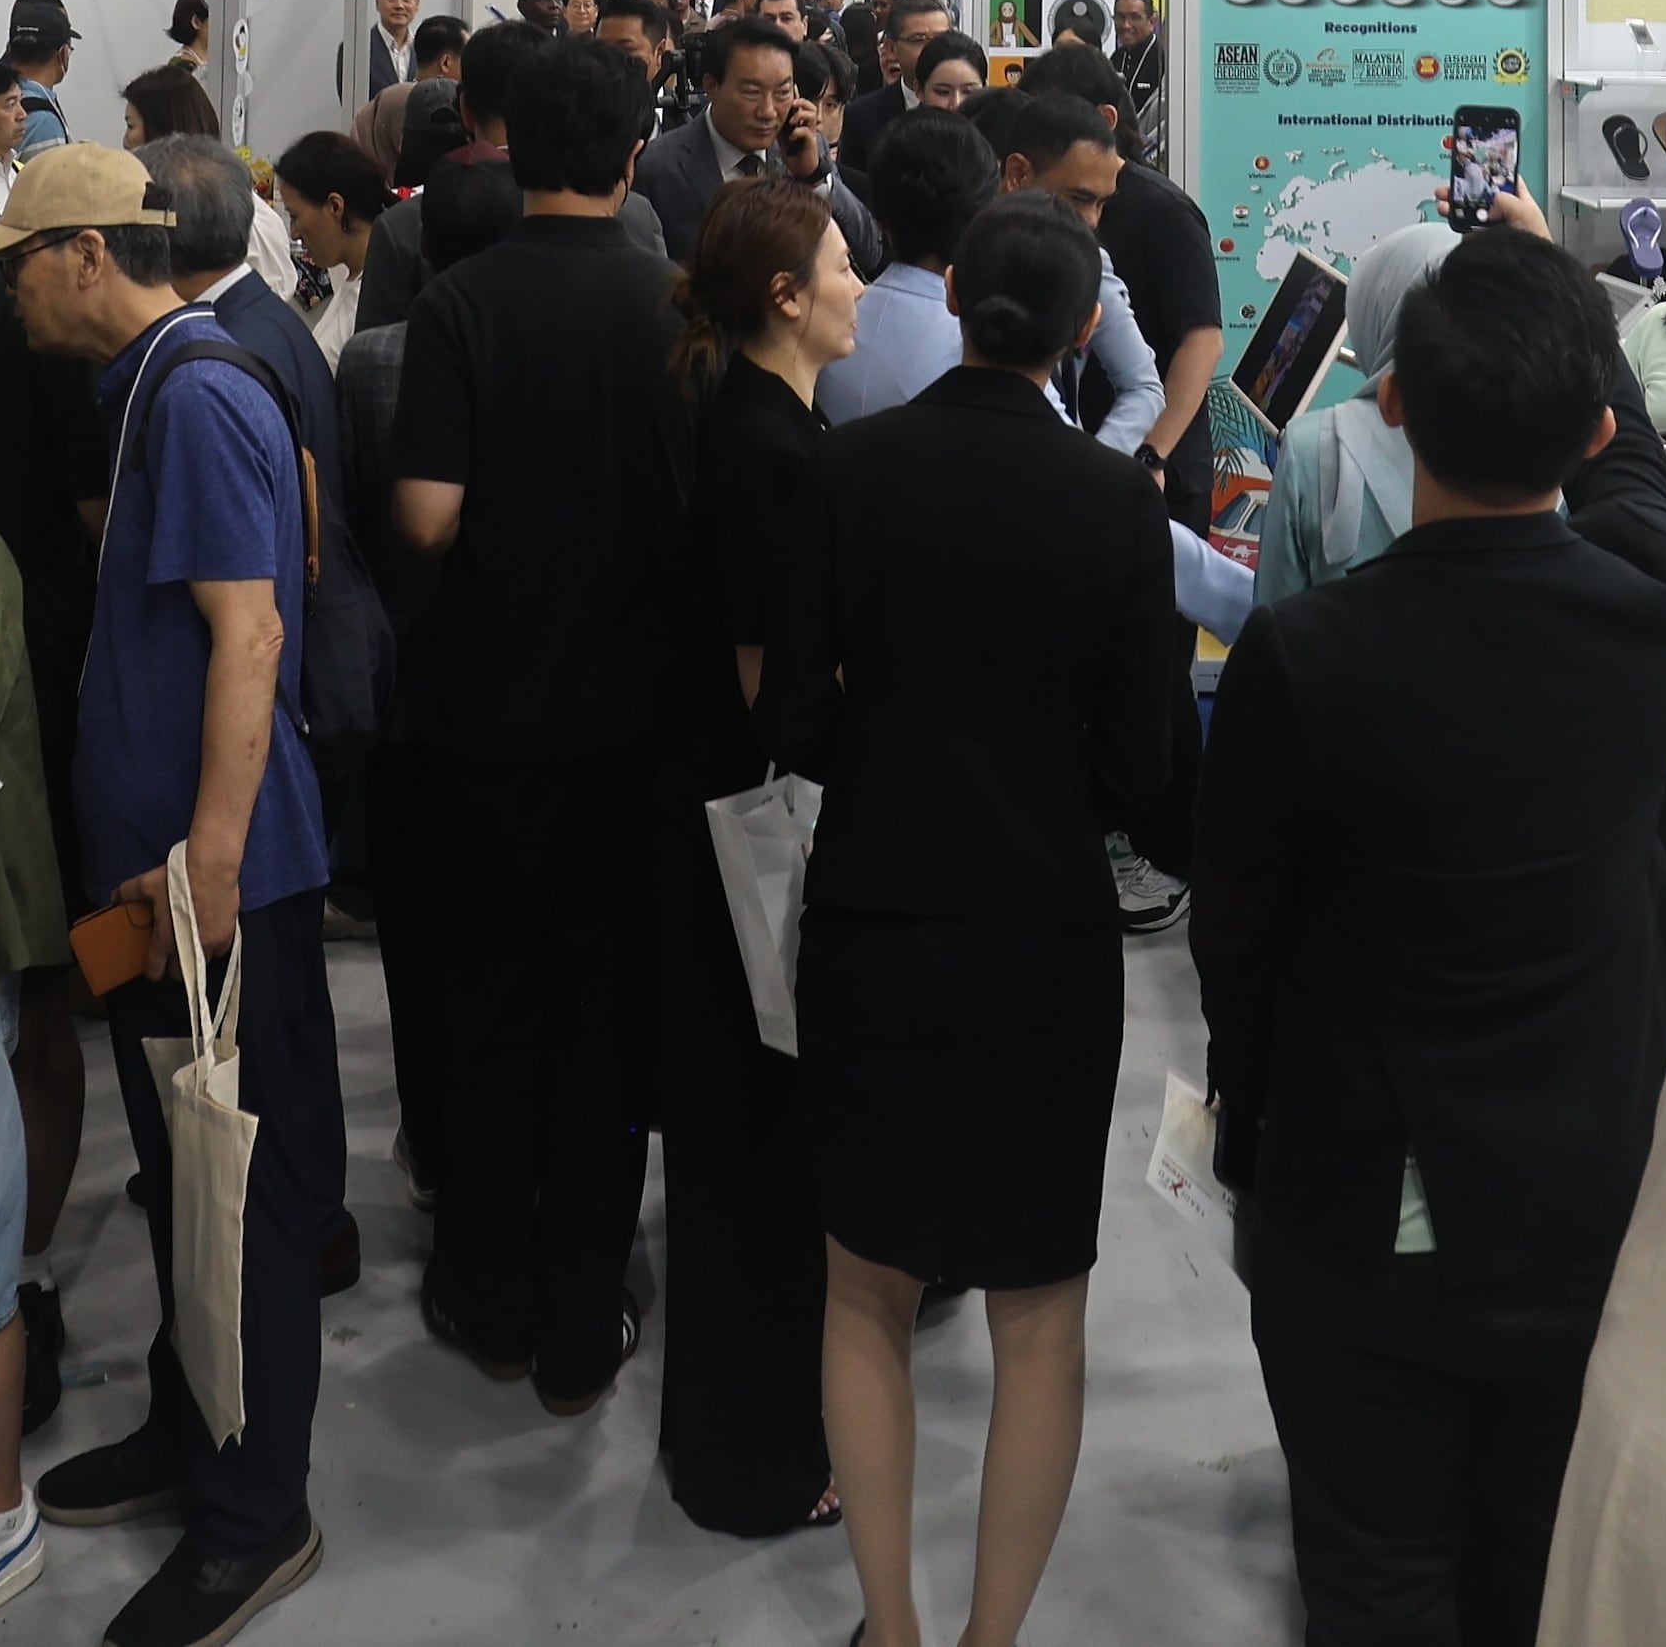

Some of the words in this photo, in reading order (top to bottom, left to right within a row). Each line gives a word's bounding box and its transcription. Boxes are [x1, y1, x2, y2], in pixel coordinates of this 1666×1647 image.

[1324, 21, 1418, 35] Recognitions
[1217, 45, 1258, 65] ASEAN
[1354, 54, 1403, 65] MALAYSIA
[1444, 54, 1487, 64] asean
[1215, 66, 1259, 81] RECORDS
[1366, 65, 1403, 79] RECORDS
[1278, 114, 1373, 126] International
[1377, 114, 1454, 126] Distributio
